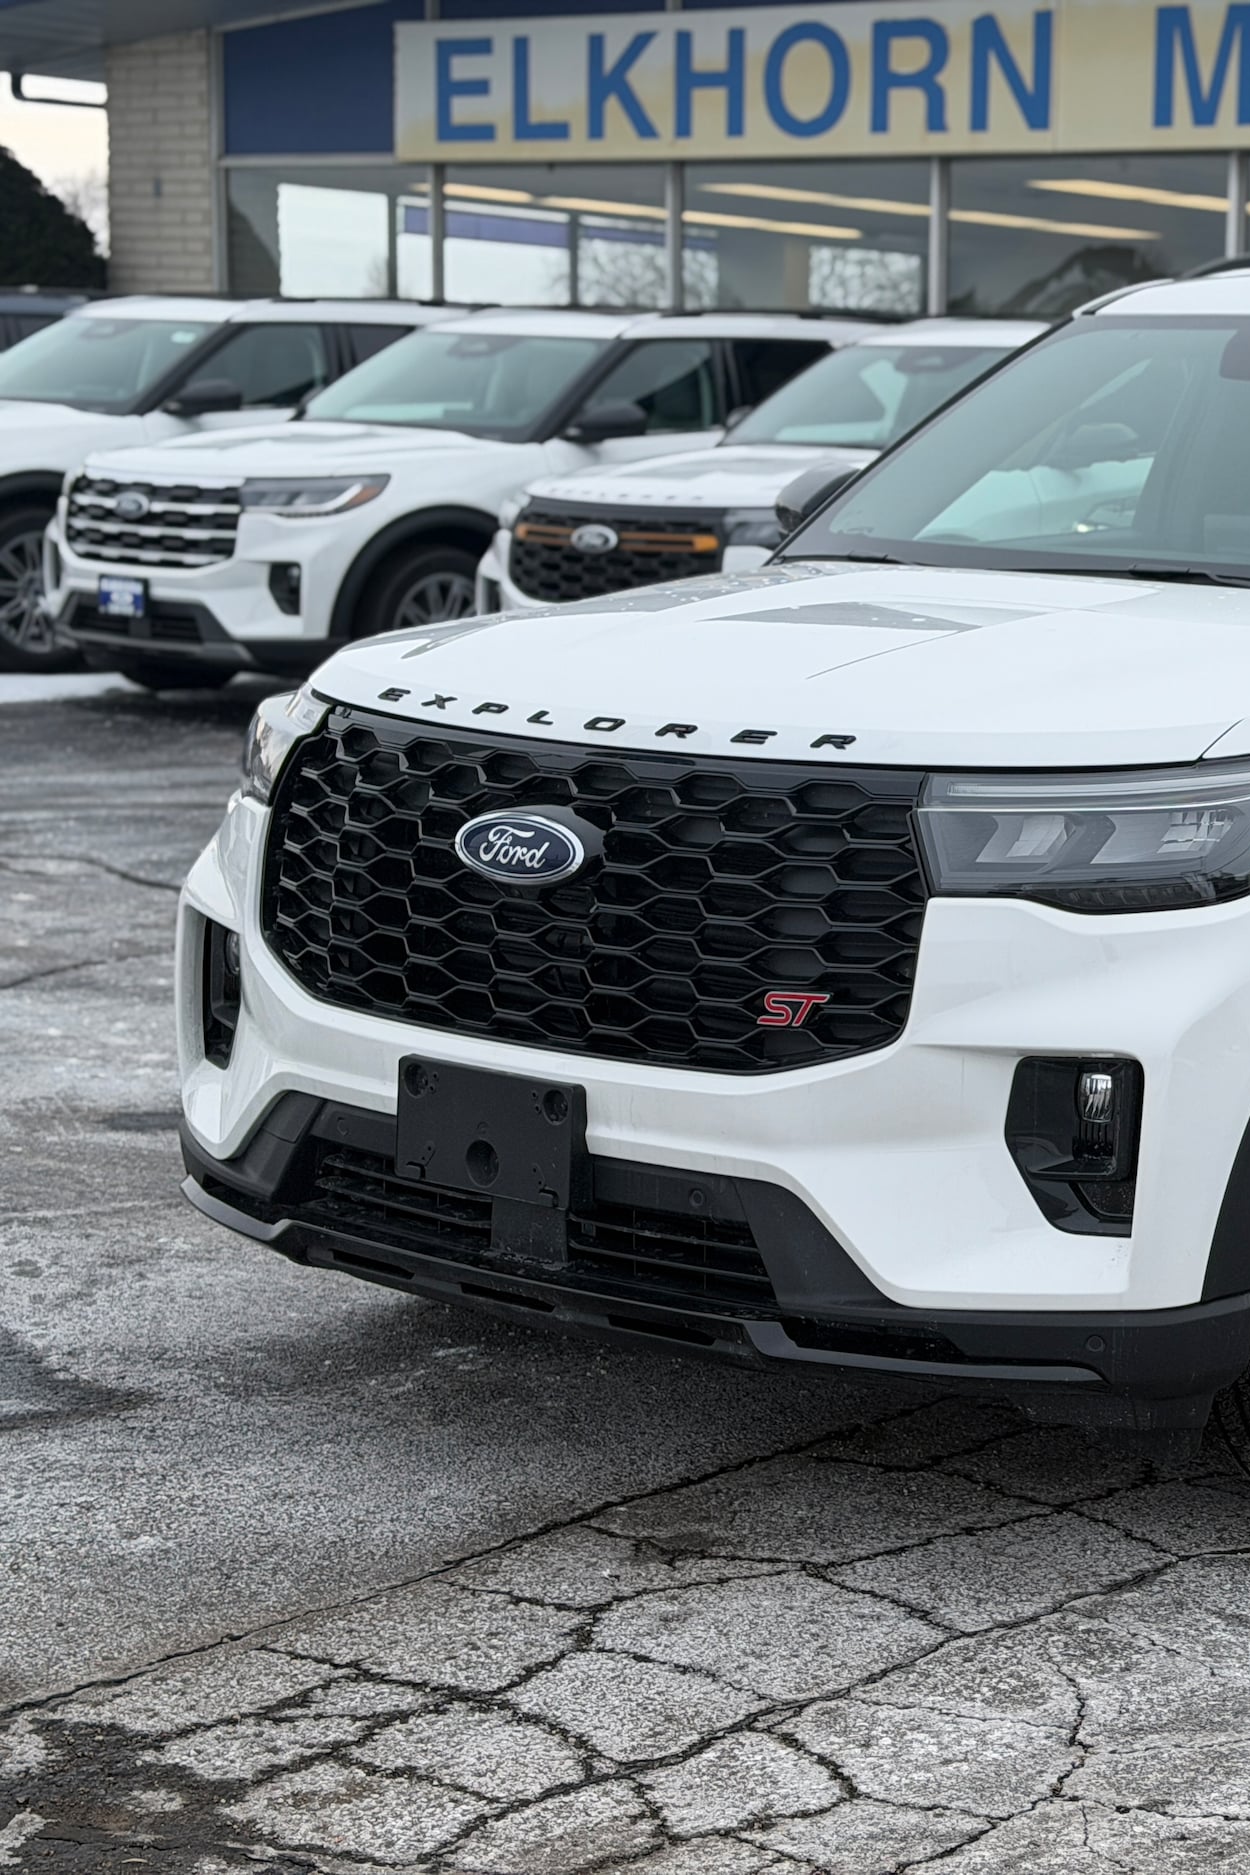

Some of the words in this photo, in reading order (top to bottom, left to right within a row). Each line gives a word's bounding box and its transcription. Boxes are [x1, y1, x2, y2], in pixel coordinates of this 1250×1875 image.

[435, 9, 1054, 143] ELKHORN
[377, 687, 857, 750] EXPLORER
[479, 825, 550, 868] Ford
[757, 991, 830, 1027] ST
